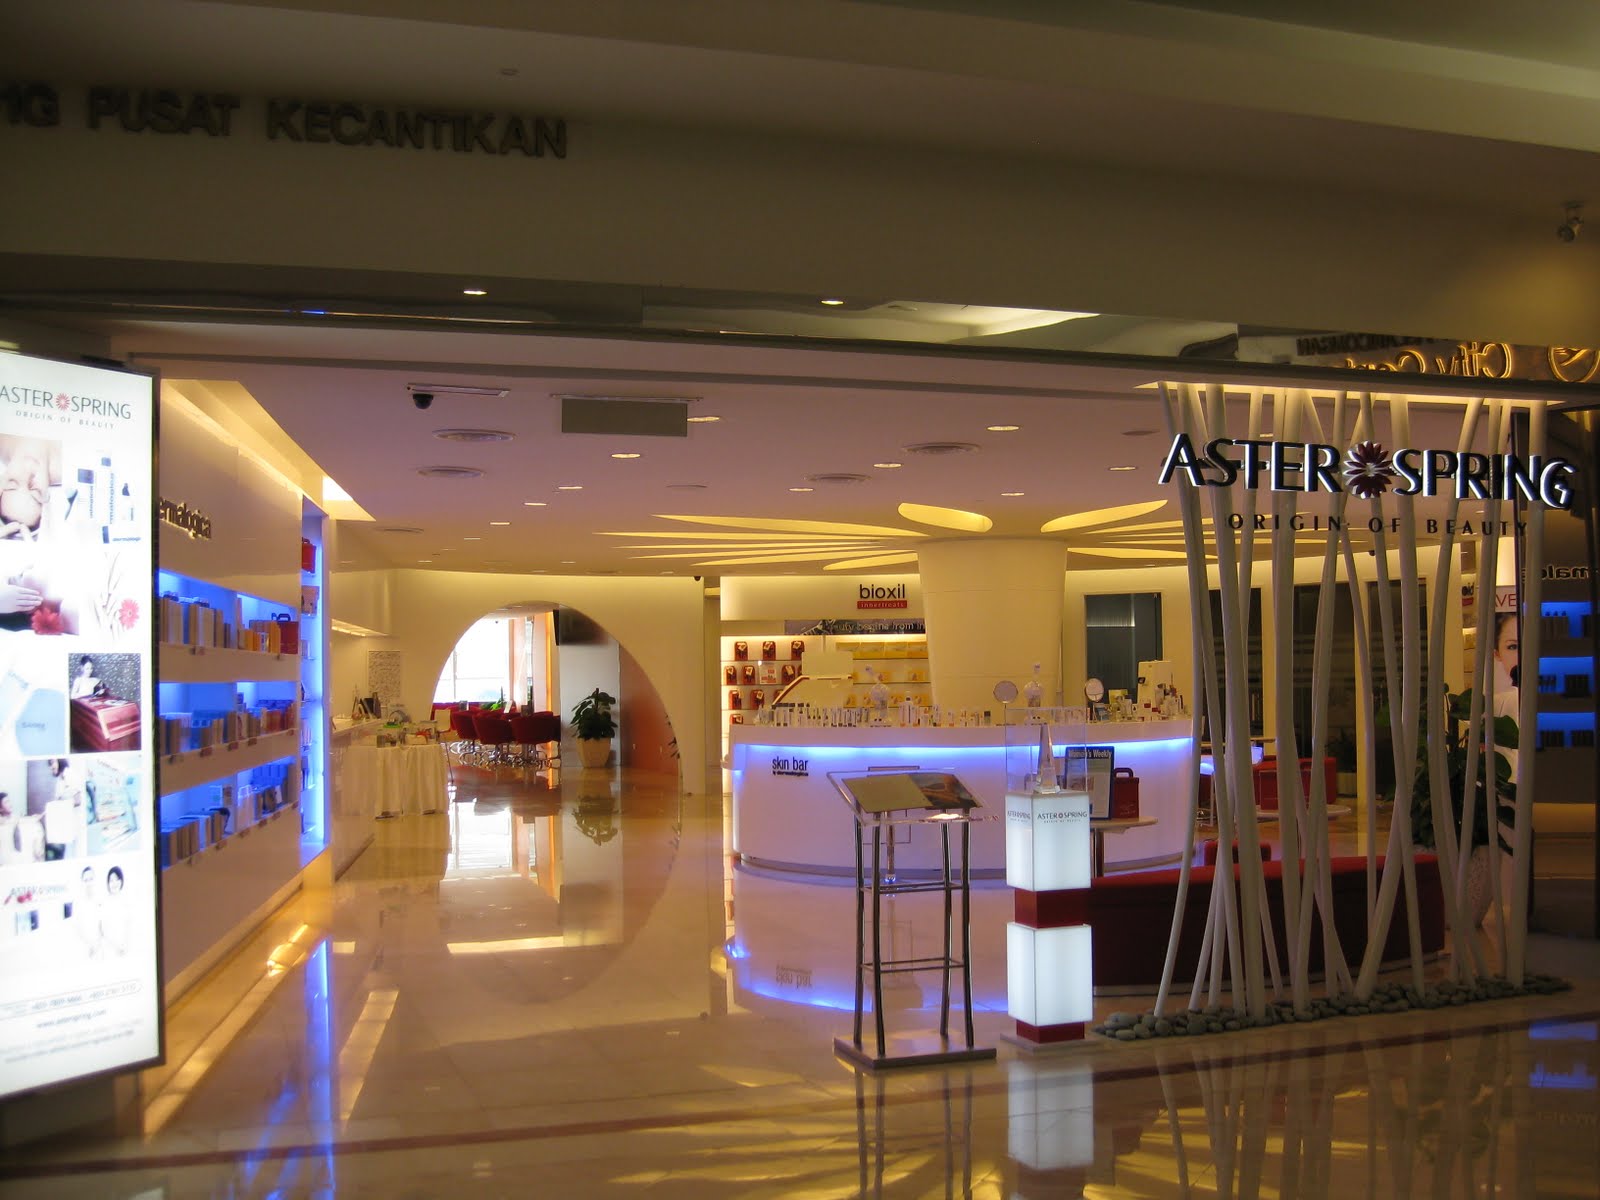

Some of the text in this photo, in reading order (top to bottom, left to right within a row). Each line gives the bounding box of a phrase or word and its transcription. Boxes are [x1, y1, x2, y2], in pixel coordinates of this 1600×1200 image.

[88, 86, 240, 137] PUSAT
[266, 100, 567, 159] KECANTIKAN
[0, 385, 131, 419] ASTER SPRING
[16, 410, 52, 420] ORIGIN
[79, 419, 114, 429] BEAUTY
[1157, 433, 1577, 508] ASTER SPRING
[1228, 513, 1527, 536] ORIGIN OF BEAUTY
[860, 584, 905, 599] bioxil
[772, 756, 808, 771] skin bar
[1093, 750, 1112, 759] Weekly
[1037, 812, 1057, 820] ASTER
